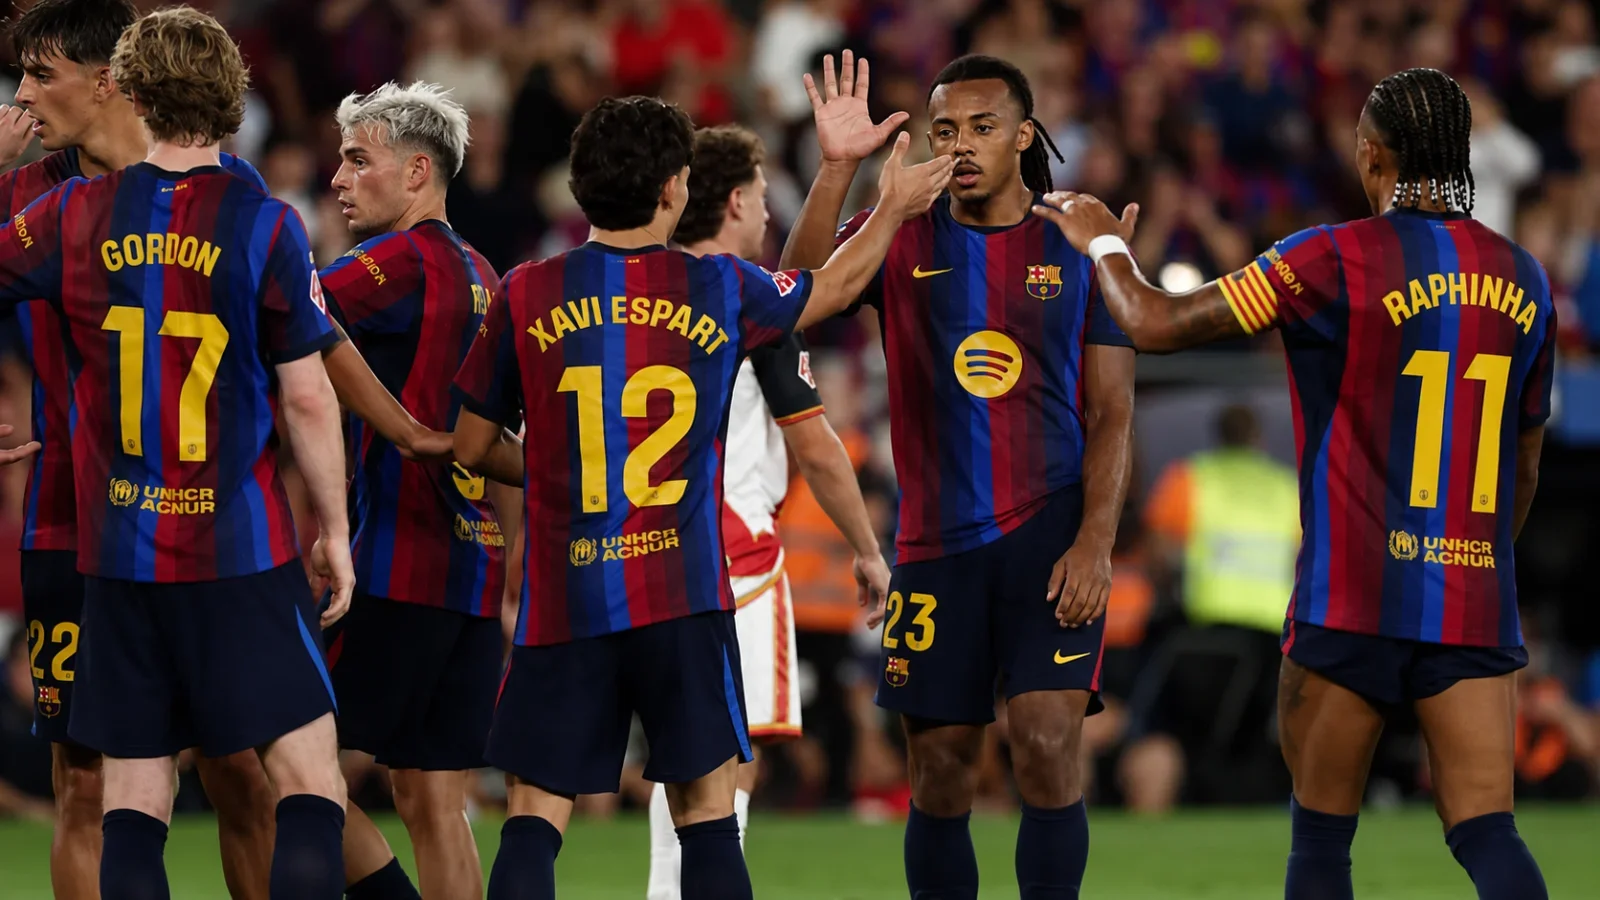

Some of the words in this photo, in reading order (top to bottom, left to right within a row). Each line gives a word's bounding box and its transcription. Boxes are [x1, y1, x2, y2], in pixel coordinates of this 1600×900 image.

[101, 233, 221, 276] GORDON
[527, 296, 602, 352] XAVI
[612, 295, 729, 355] ESPART
[1382, 273, 1537, 334] RAPHINHA
[102, 306, 229, 461] 17
[557, 365, 696, 513] 12
[1402, 350, 1511, 513] 11
[140, 499, 215, 515] ACNUR
[143, 486, 214, 501] UNHCR
[602, 529, 677, 549] UNHCR
[602, 536, 680, 562] ACNUR
[1424, 536, 1492, 555] UNHCR
[1424, 549, 1496, 569] ACNUR
[882, 591, 938, 652] 23
[29, 619, 80, 682] 22
